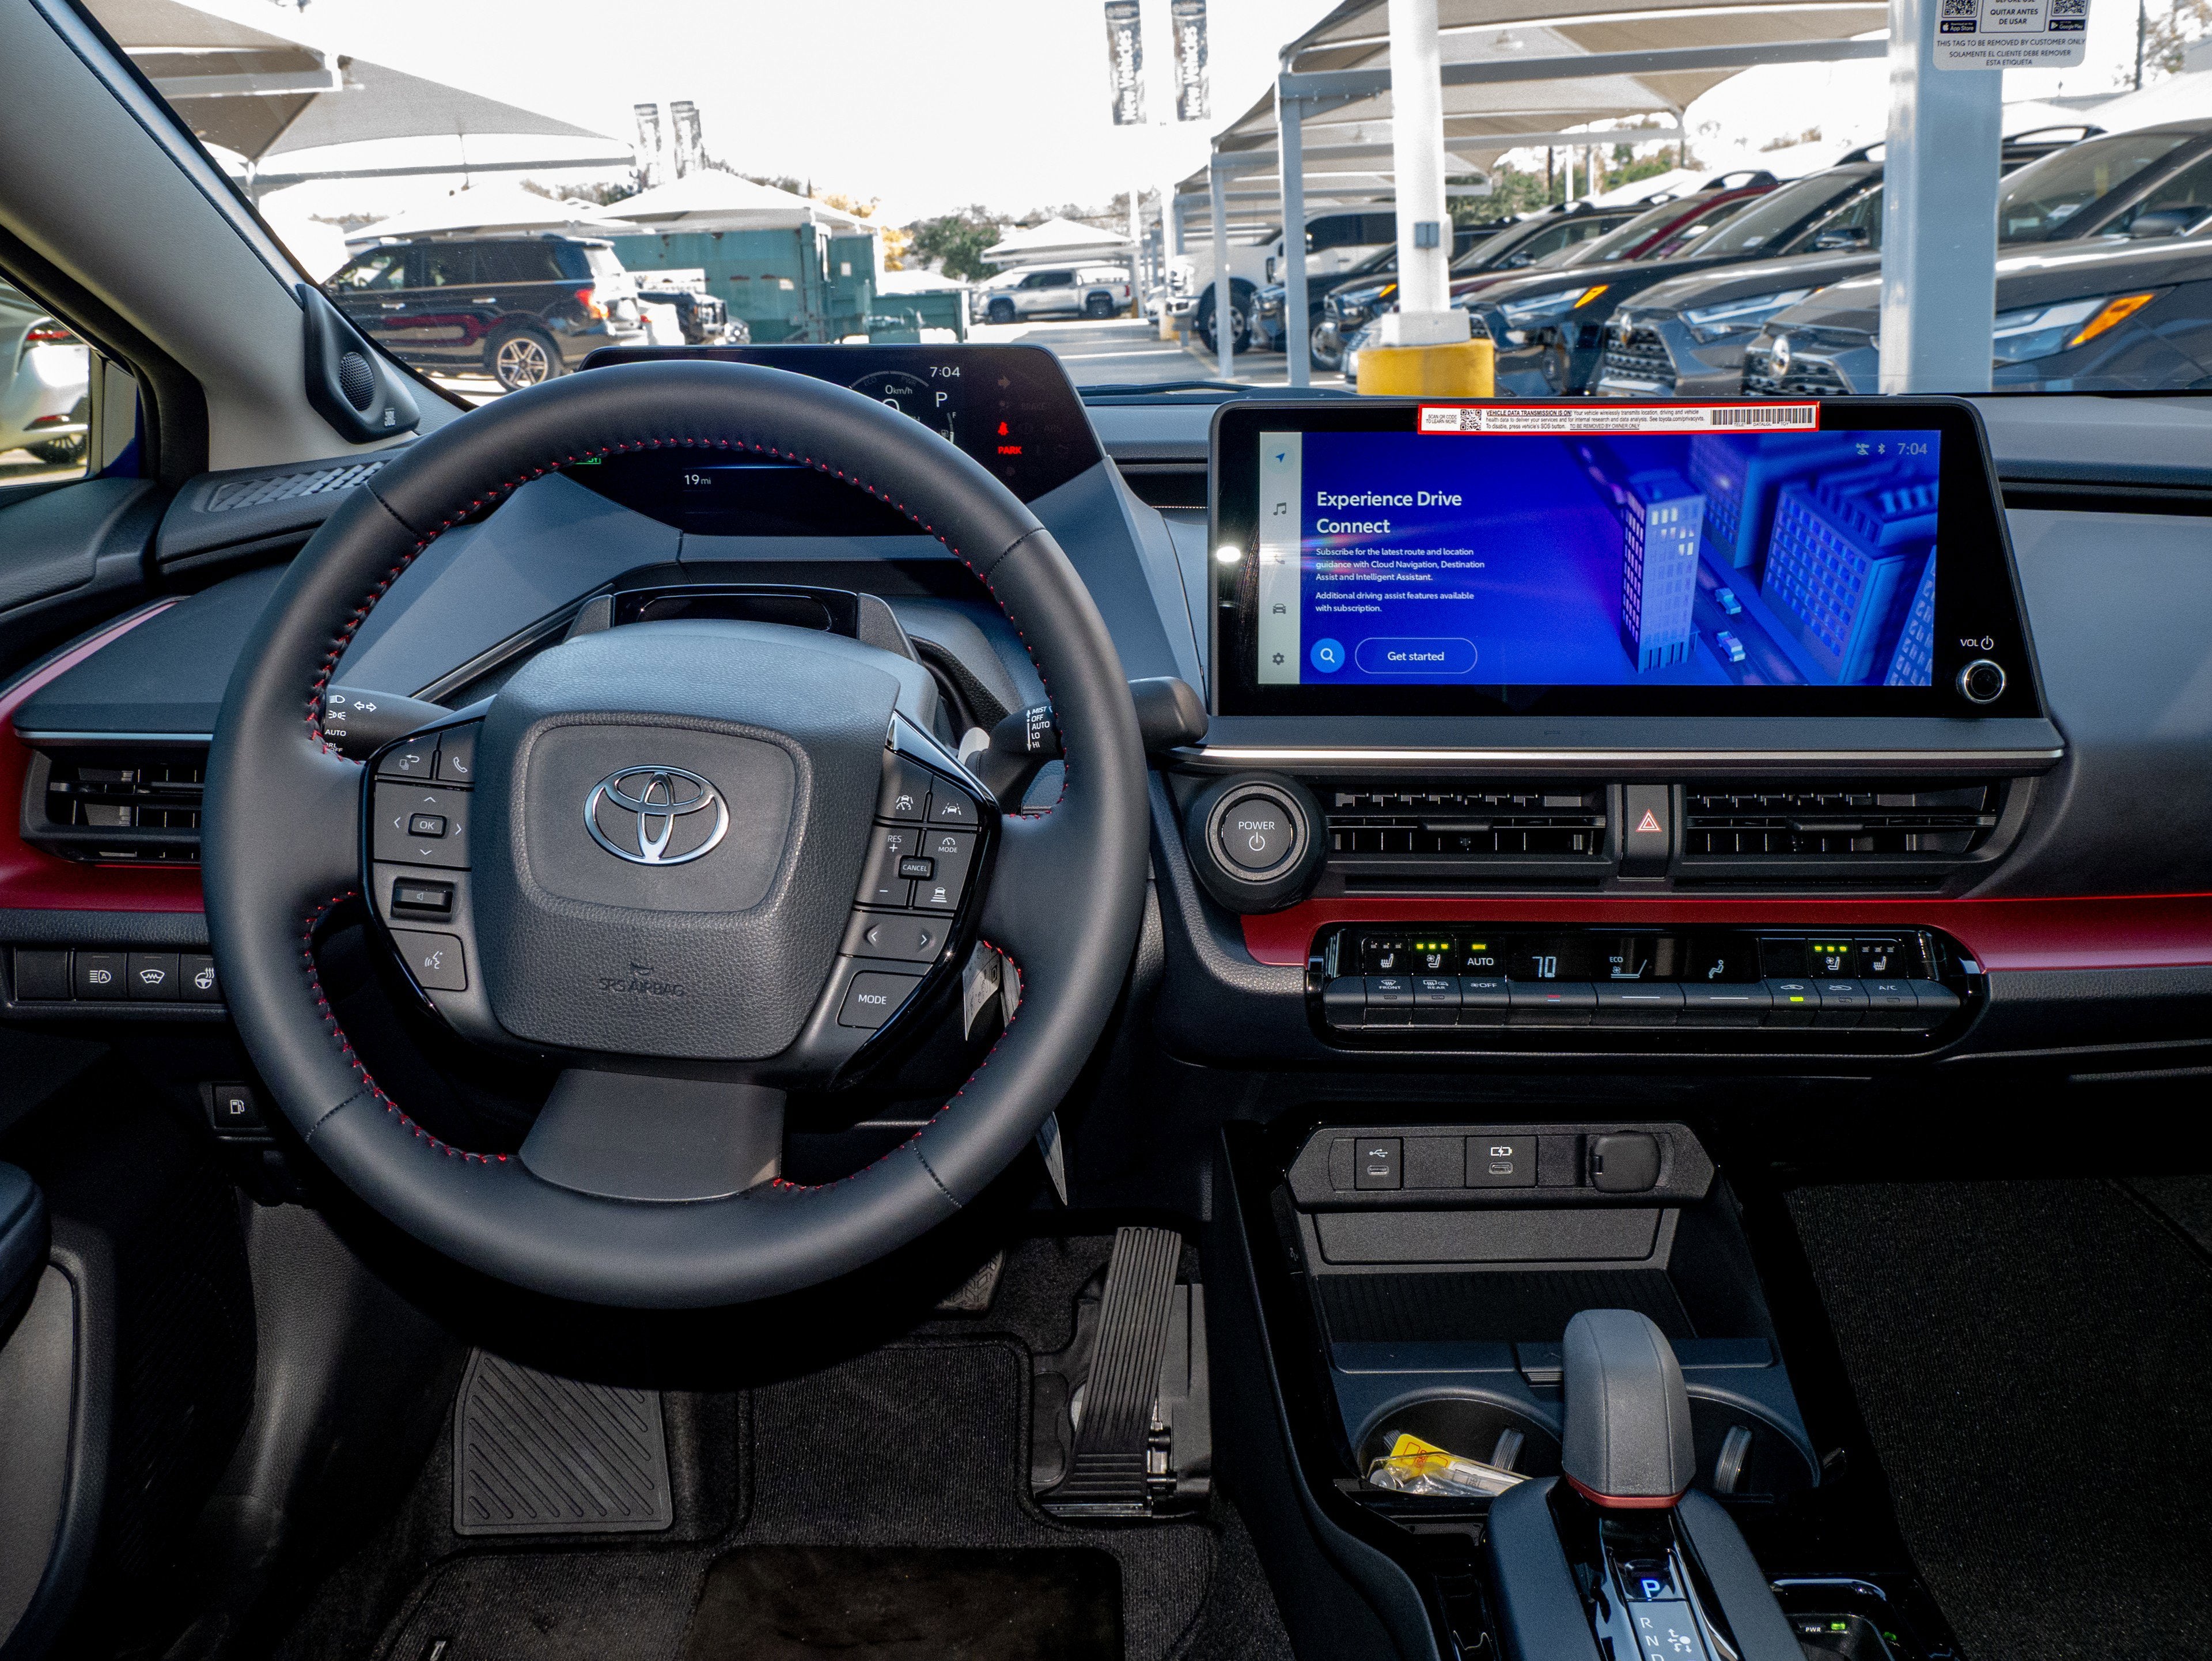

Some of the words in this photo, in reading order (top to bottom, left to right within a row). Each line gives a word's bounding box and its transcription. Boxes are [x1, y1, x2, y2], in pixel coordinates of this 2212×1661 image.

[930, 367, 960, 377] 7:04
[935, 392, 947, 407] P
[998, 446, 1022, 454] PARK
[1897, 443, 1927, 455] 7:04
[1317, 491, 1412, 509] Experience
[1417, 491, 1462, 507] Drive
[1316, 519, 1391, 534] Connect
[1316, 561, 1351, 569] guidance
[1396, 561, 1439, 569] Navigation,
[1356, 573, 1395, 582] Intelligent
[1357, 592, 1382, 600] driving
[1334, 604, 1382, 613] subscription.
[1387, 652, 1406, 661] Get
[1409, 652, 1444, 661] started
[1032, 706, 1047, 714] MIST
[1032, 721, 1050, 731] AUTO
[419, 822, 434, 830] OK
[1238, 821, 1275, 830] POWER
[1467, 958, 1494, 966] AUTO
[1532, 956, 1556, 978] 70
[858, 994, 887, 1005] MODE
[1642, 1579, 1660, 1598] P
[1640, 1617, 1653, 1628] R
[1645, 1635, 1659, 1646] N
